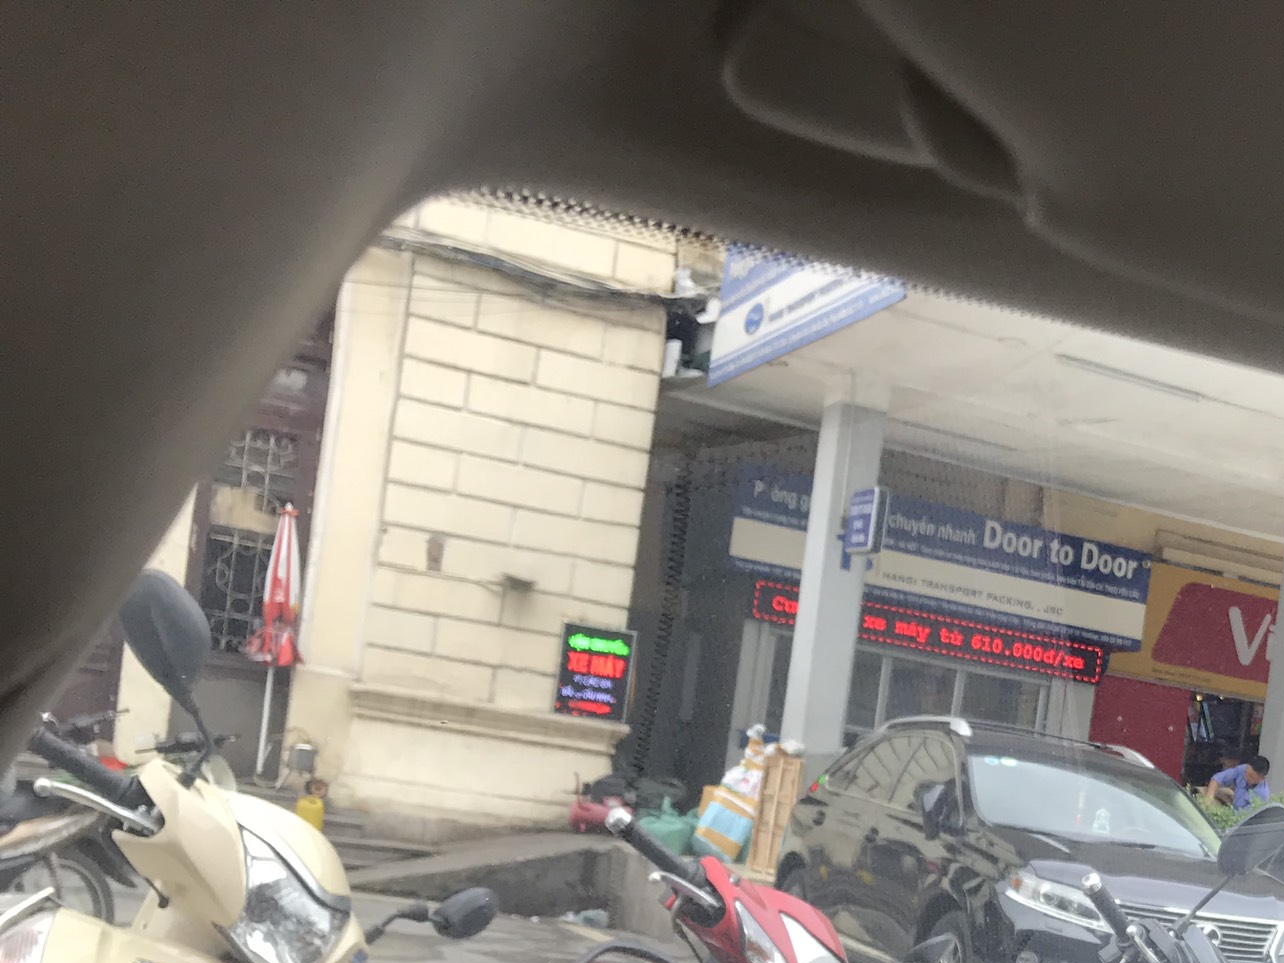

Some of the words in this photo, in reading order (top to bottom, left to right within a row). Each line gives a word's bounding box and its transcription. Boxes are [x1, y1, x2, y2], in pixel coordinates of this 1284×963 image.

[938, 524, 977, 546] nhanh
[983, 518, 1044, 559] Door
[1050, 537, 1074, 566] to
[1080, 541, 1138, 580] Door
